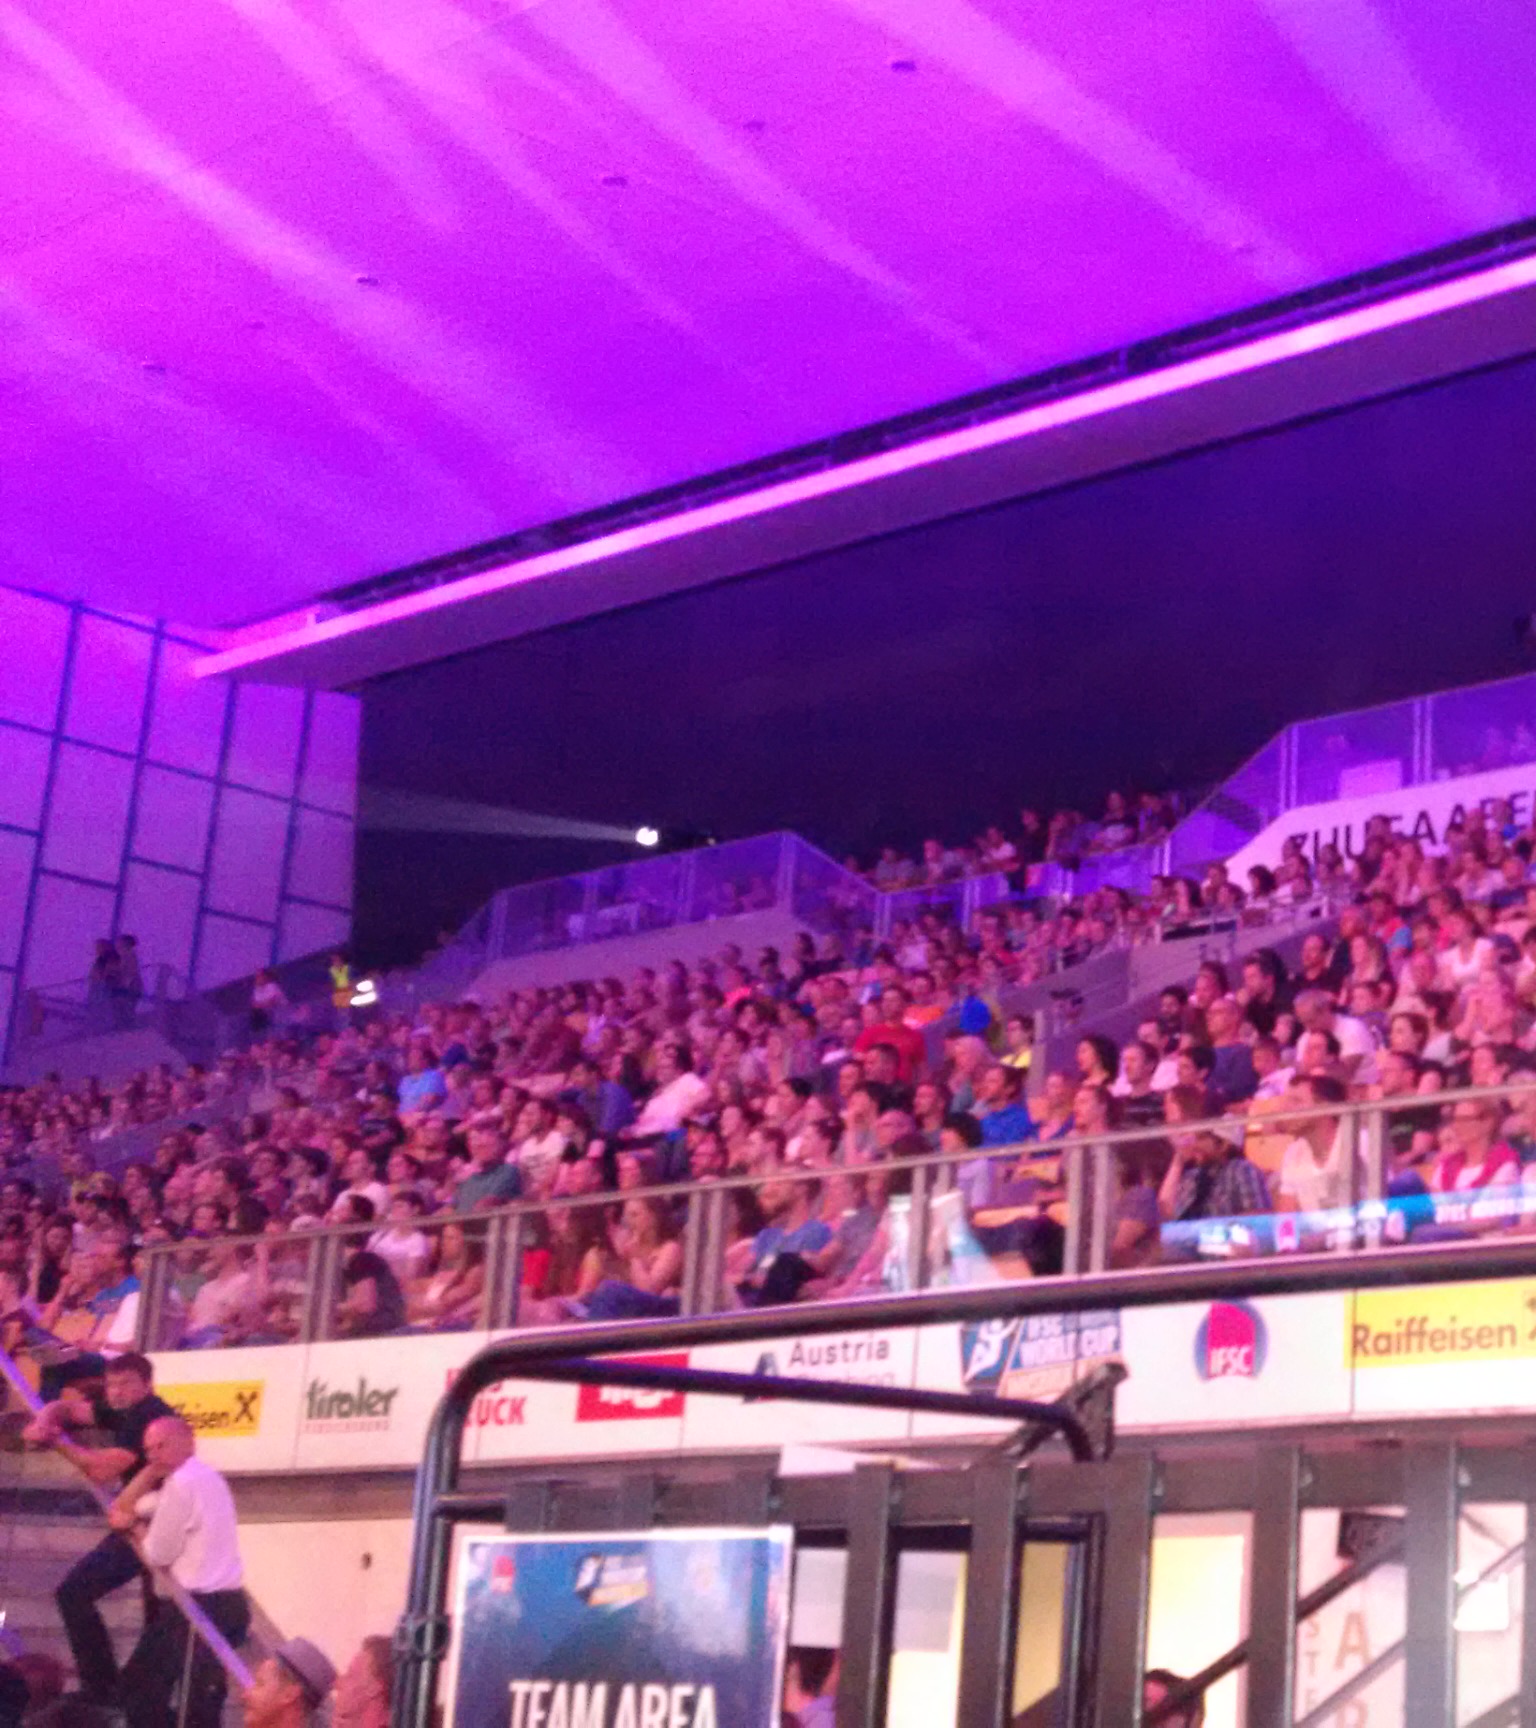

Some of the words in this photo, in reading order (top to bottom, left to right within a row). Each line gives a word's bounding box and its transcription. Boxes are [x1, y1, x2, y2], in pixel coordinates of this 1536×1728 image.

[789, 1339, 891, 1368] Austria
[1351, 1314, 1517, 1357] Raiffeisen
[1211, 1346, 1253, 1375] IFSC
[307, 1375, 399, 1421] tiroler
[509, 1680, 608, 1728] TEAM
[612, 1682, 718, 1728] AREA
